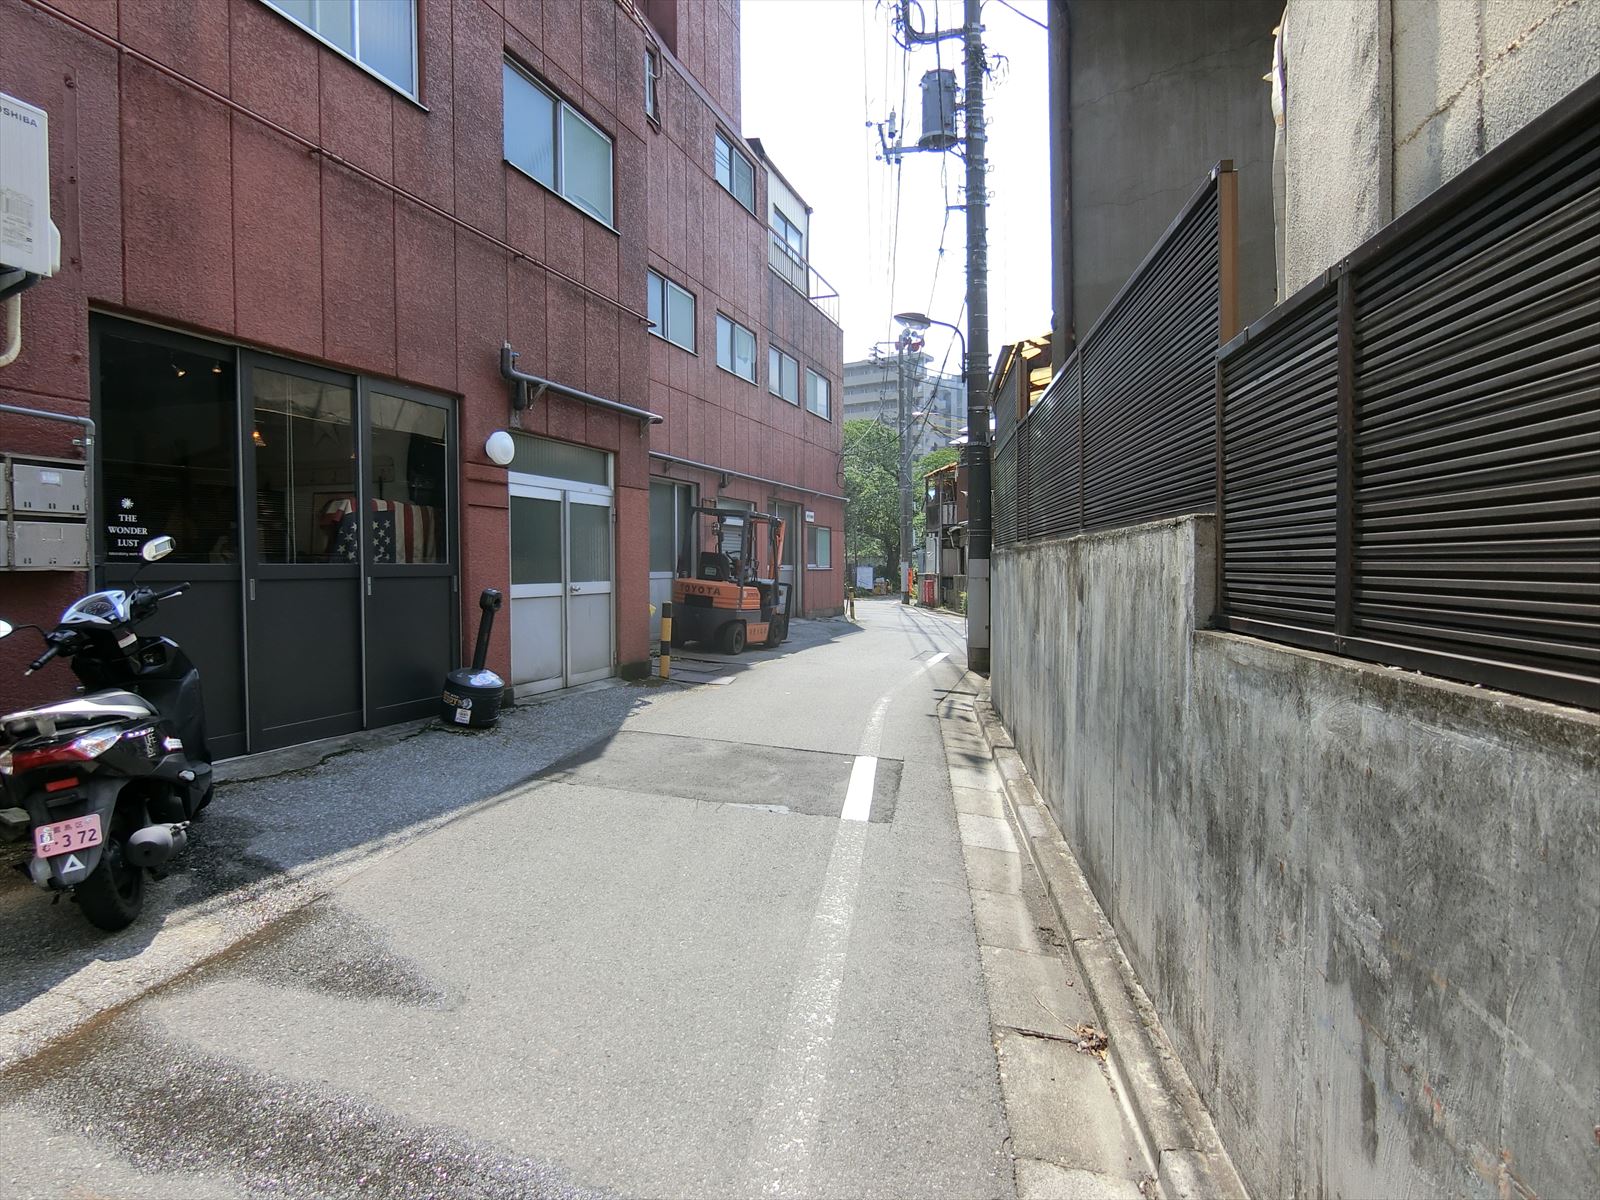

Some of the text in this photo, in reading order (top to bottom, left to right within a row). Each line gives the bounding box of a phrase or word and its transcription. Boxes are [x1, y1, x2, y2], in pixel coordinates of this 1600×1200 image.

[118, 514, 138, 522] THE
[108, 526, 148, 535] WONDER
[117, 539, 139, 547] LUST
[680, 584, 720, 596] TOYOTA
